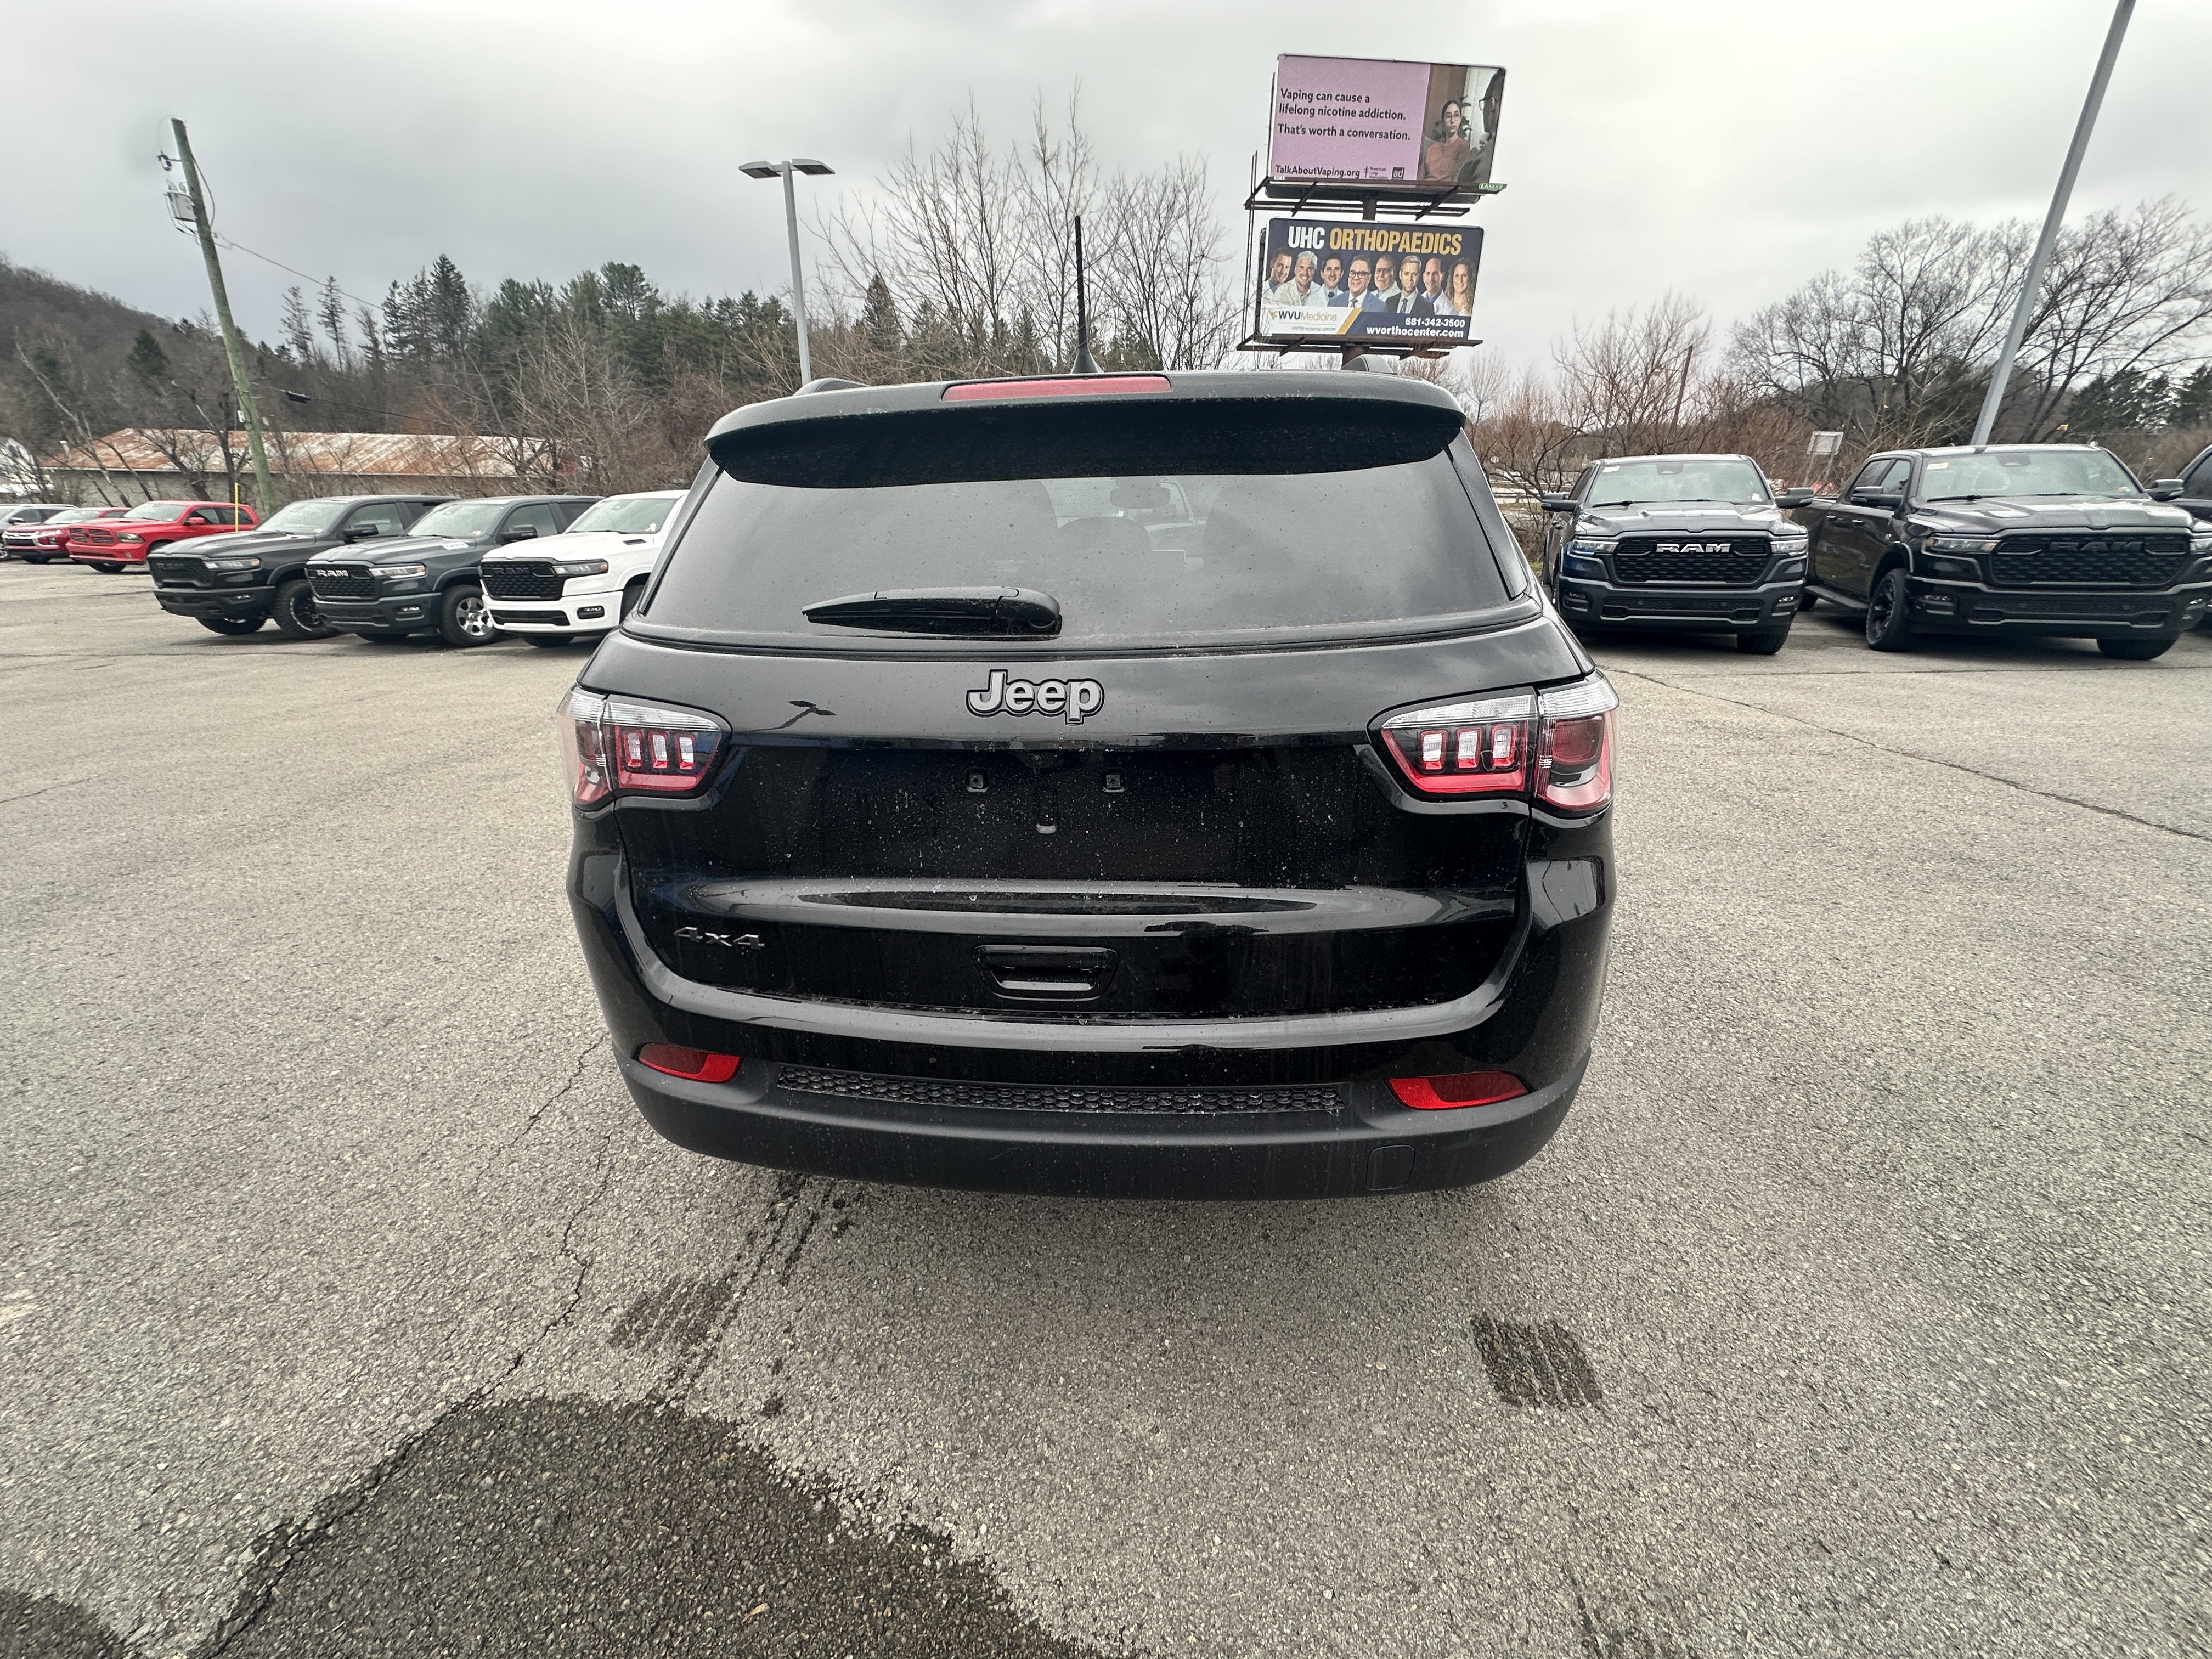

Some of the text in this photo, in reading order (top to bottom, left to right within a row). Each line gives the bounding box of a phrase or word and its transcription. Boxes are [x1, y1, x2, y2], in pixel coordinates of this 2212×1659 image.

[1281, 88, 1313, 103] Vaping
[1316, 92, 1332, 101] can
[1335, 93, 1363, 103] cause
[1279, 103, 1406, 120] lifelong nicotine addiction.
[1278, 123, 1410, 140] That's worth a conversation.
[1275, 165, 1361, 179] TalkAboutVaping.org
[1288, 225, 1463, 255] UHC ORTHOPAEDICS
[1405, 317, 1465, 328] 681-342-3500
[1366, 326, 1464, 338] wvorthocenter.com
[1656, 543, 1732, 552] RAM
[2050, 541, 2143, 551] RAM
[967, 669, 1104, 724] Jeep
